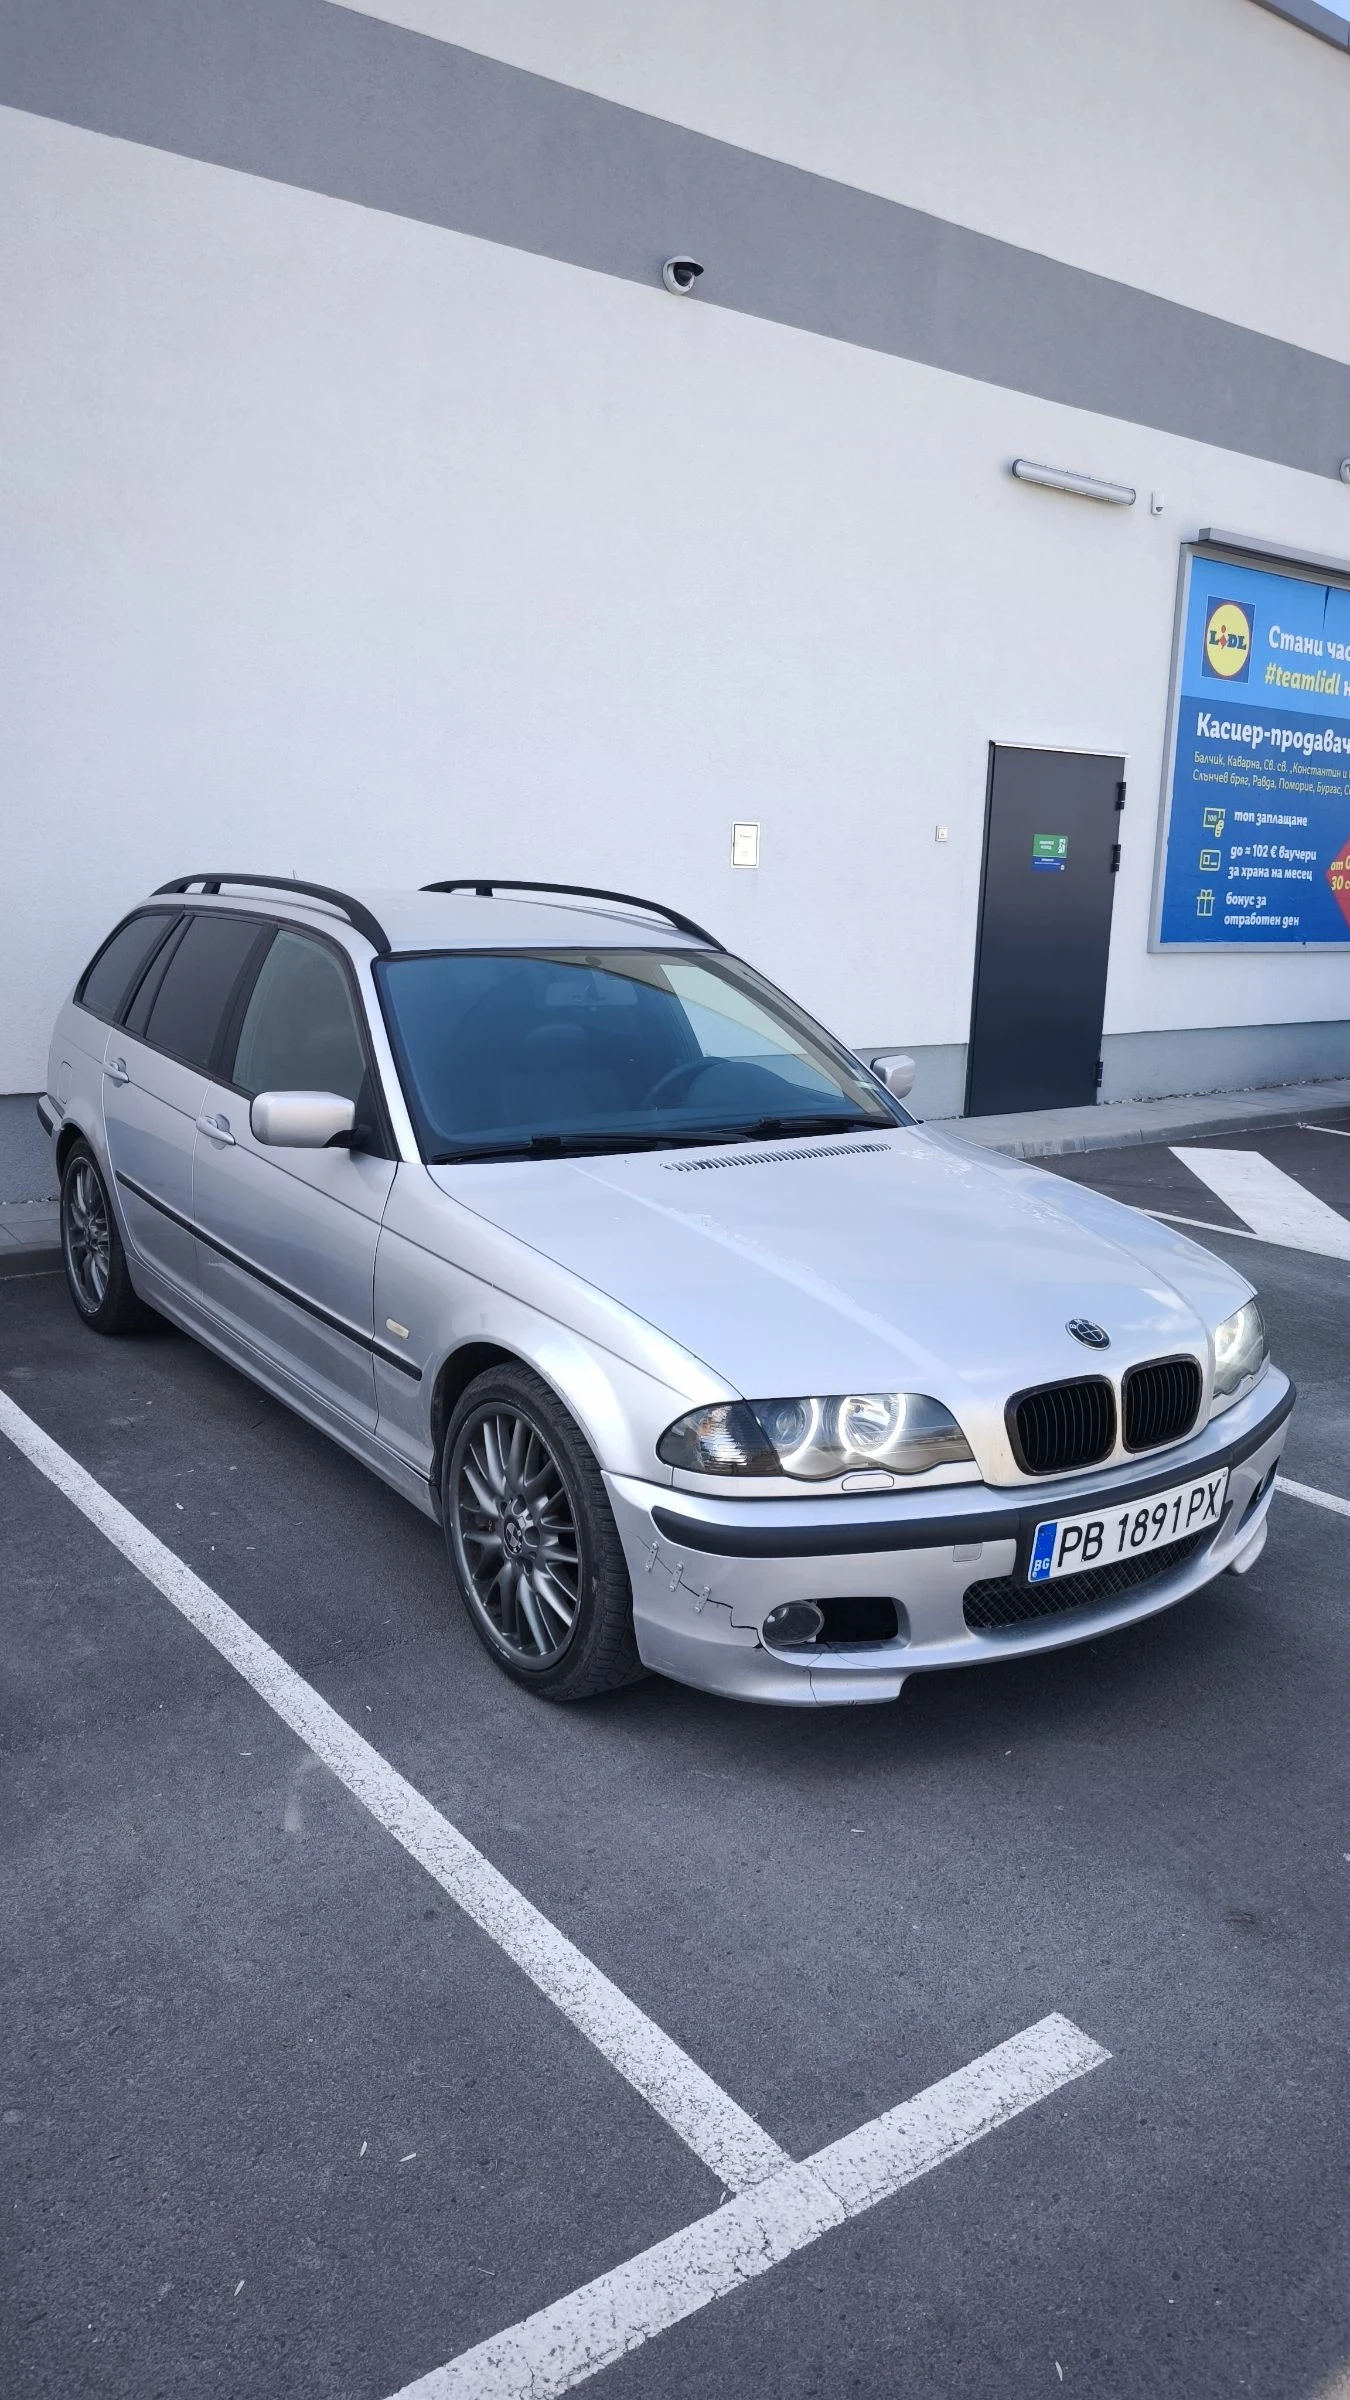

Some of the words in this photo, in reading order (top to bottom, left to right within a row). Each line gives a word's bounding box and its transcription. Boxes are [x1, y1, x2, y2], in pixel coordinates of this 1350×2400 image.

[1268, 625, 1323, 657] Стани
[1265, 662, 1340, 695] #teamlidl
[1227, 754, 1262, 770] Каварна,
[1263, 759, 1276, 771] Св.
[1192, 768, 1229, 784] Слънчев
[1230, 772, 1251, 787] бряг,
[1252, 774, 1277, 791] Равда,
[1278, 777, 1315, 793] Поморие,
[1316, 781, 1343, 796] Бургас,
[1234, 811, 1255, 822] топ
[1255, 812, 1308, 827] заплащане
[1230, 846, 1244, 859] до
[1252, 844, 1269, 858] 102
[1278, 845, 1317, 863] ваучери
[1228, 866, 1240, 880] за
[1241, 866, 1270, 880] храна
[1271, 868, 1283, 879] на
[1284, 868, 1313, 881] месец
[1331, 875, 1344, 891] 30
[1225, 891, 1255, 908] бонус
[1255, 896, 1267, 909] за
[1224, 912, 1281, 928] отработен
[1282, 916, 1300, 928] ден
[1057, 1521, 1105, 1568] PB
[1118, 1495, 1183, 1552] 1891
[1186, 1478, 1222, 1528] PX
[1033, 1557, 1051, 1572] BG
